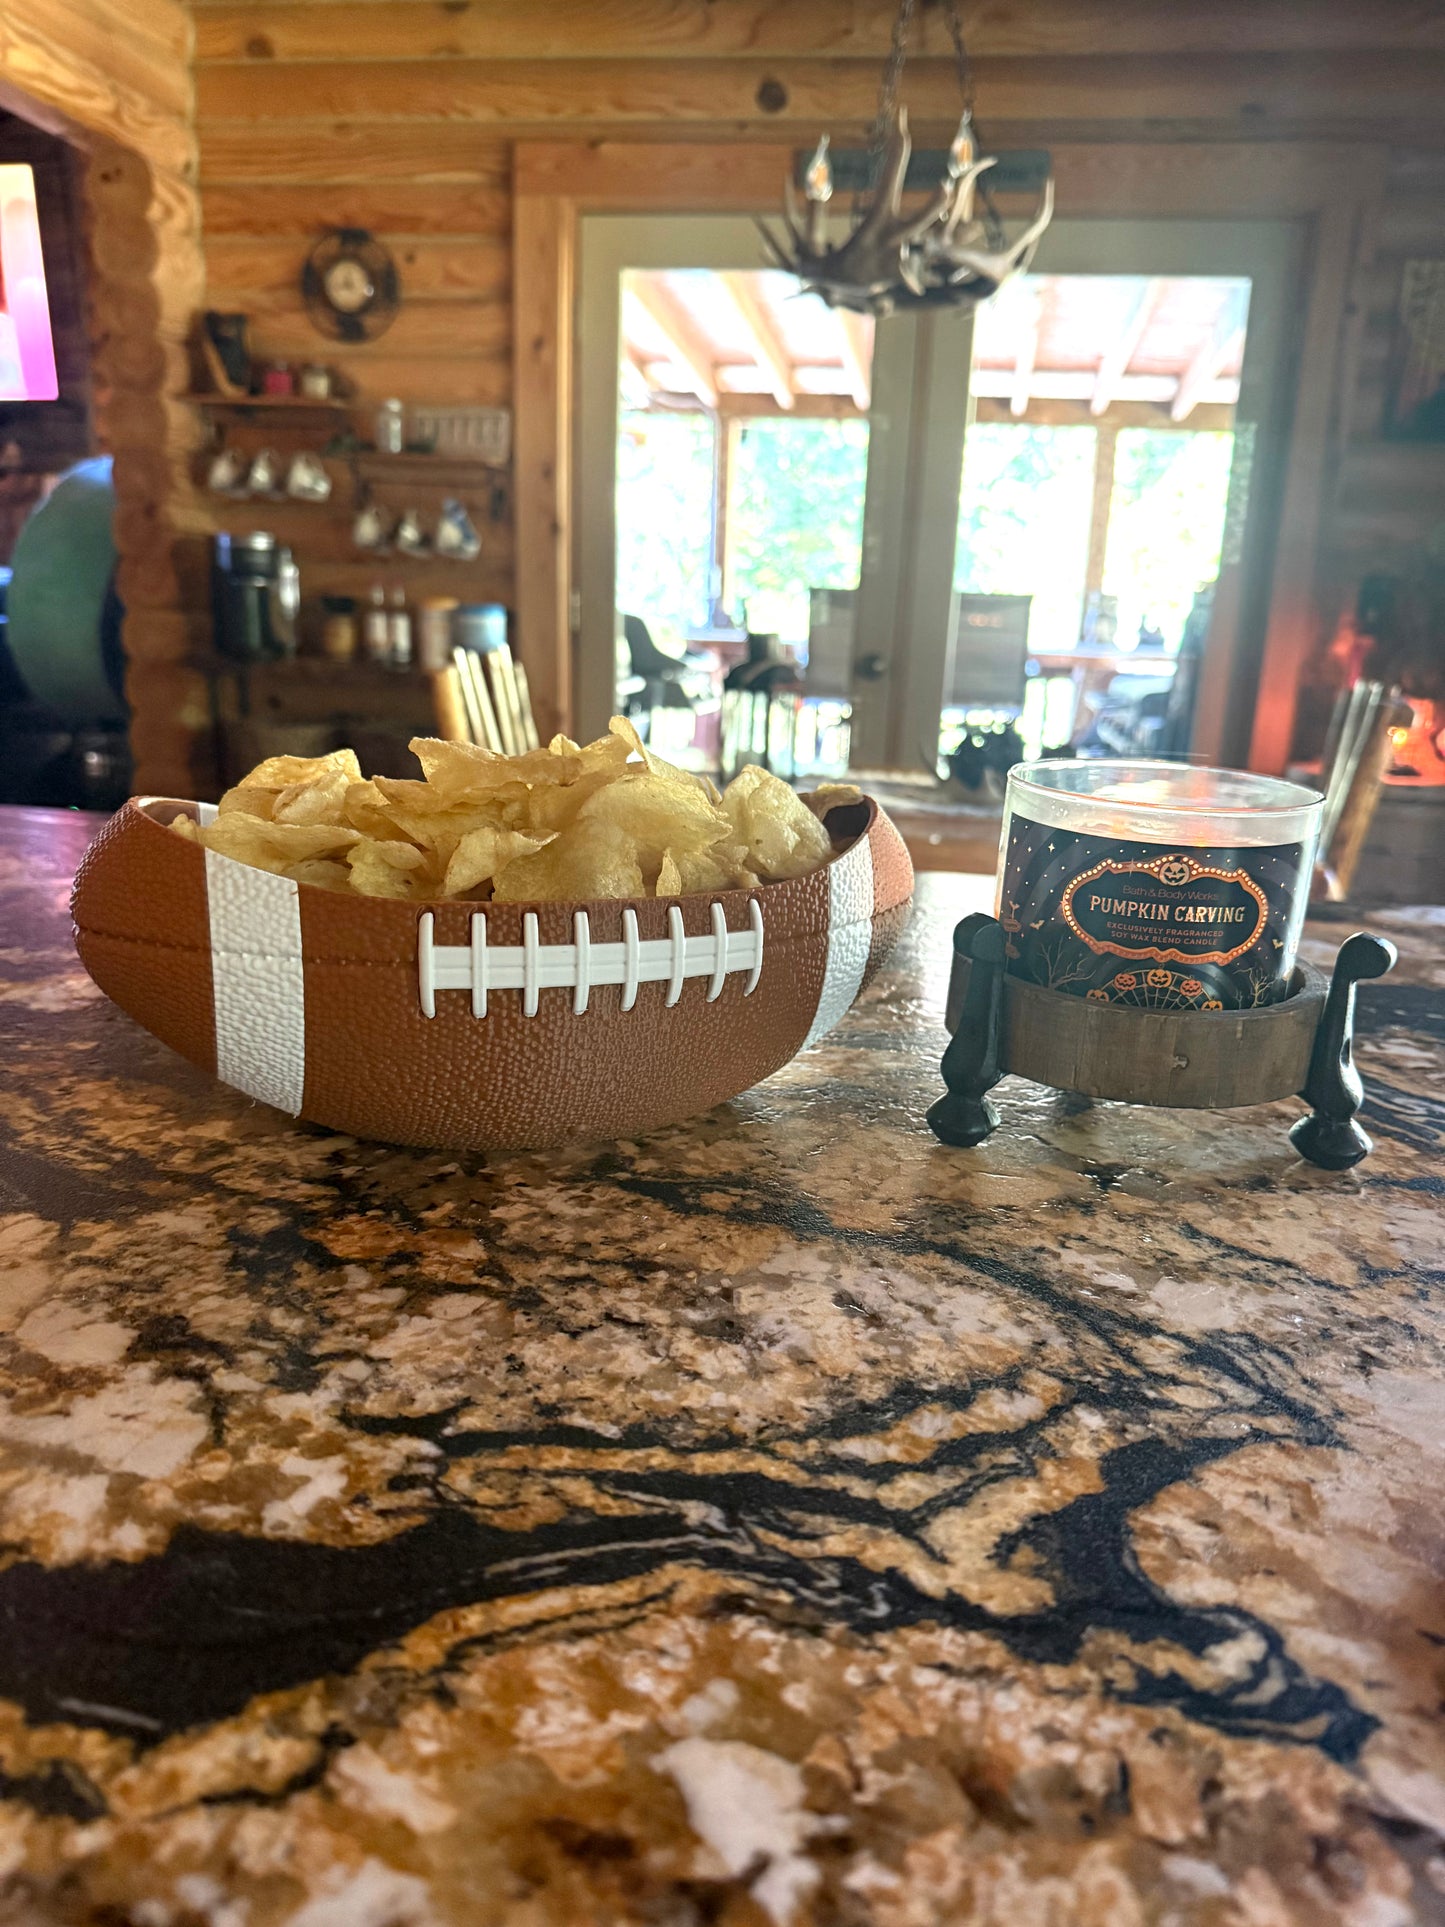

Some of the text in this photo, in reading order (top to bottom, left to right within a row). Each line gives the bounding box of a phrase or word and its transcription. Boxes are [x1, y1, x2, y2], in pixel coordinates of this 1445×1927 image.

[1122, 884, 1219, 901] Bath & Body Works
[1090, 895, 1245, 923] PUMPKIN CARVING
[1106, 921, 1224, 937] EXCLUSIVELY FRAGRANCED
[1111, 930, 1218, 946] SOY WAX BLEND CANDLE
